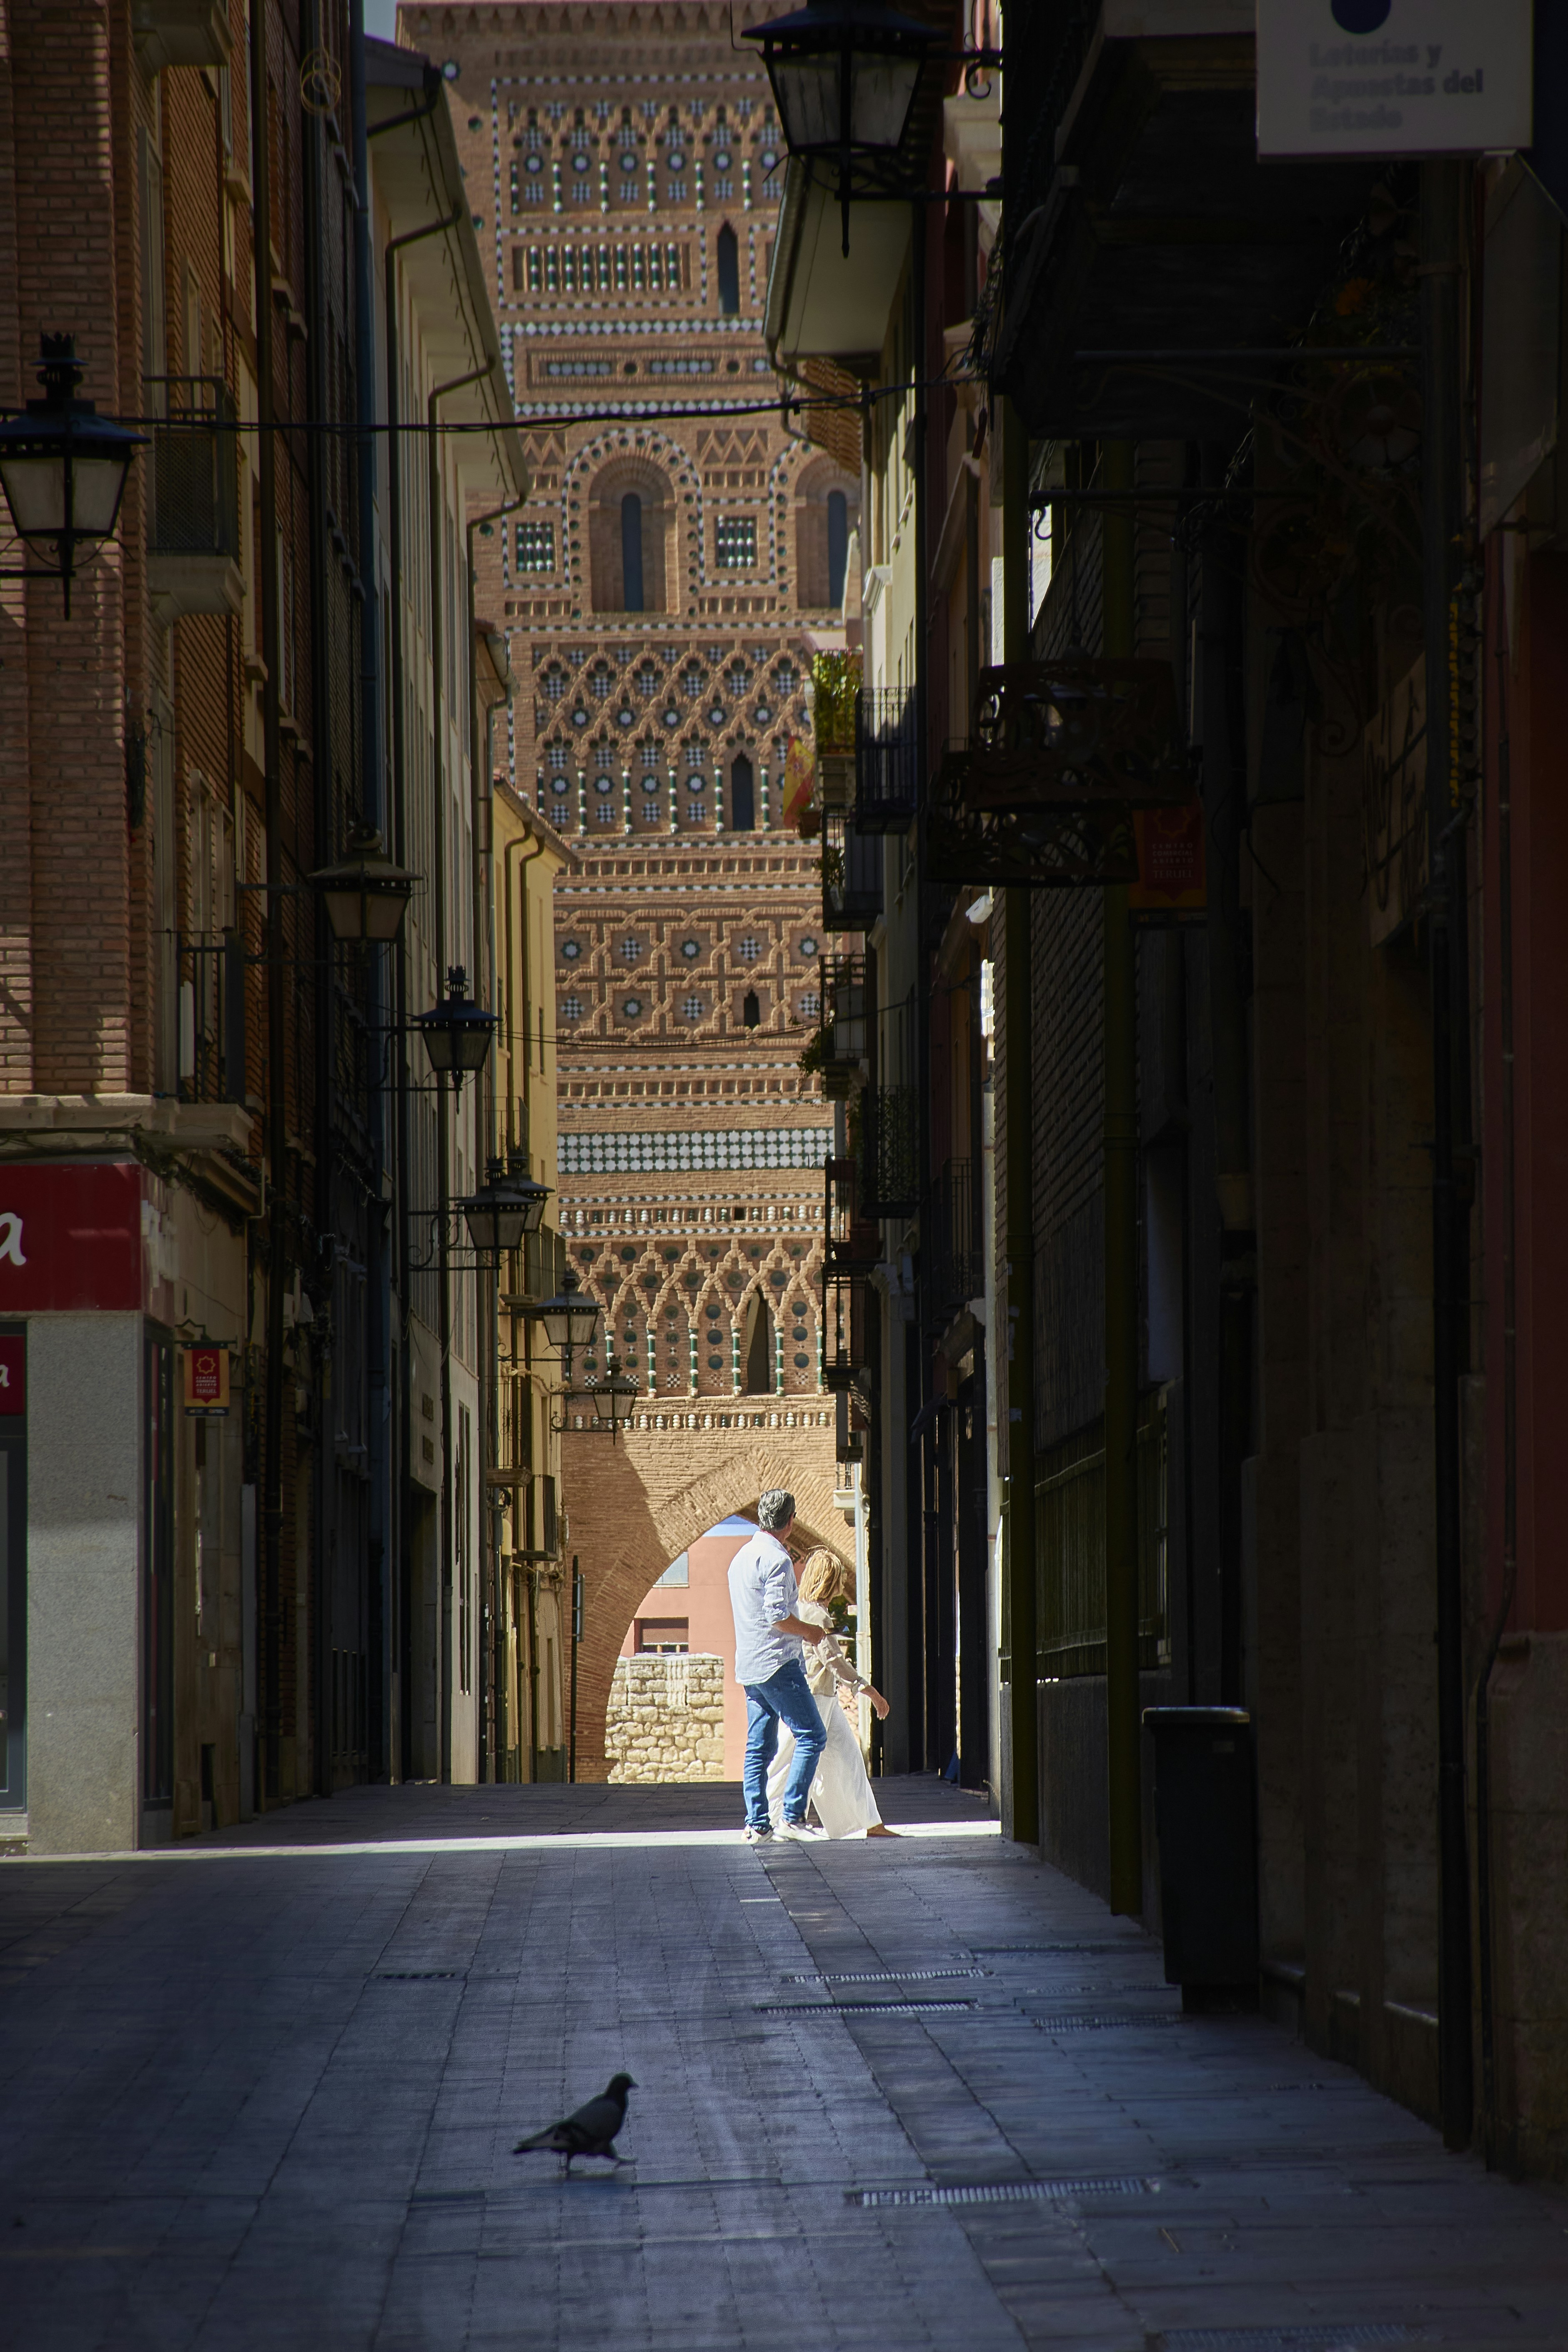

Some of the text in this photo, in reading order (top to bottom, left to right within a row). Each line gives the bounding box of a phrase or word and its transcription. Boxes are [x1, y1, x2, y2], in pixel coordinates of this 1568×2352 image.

[1427, 45, 1442, 68] y
[1311, 68, 1483, 105] Apuestas del
[1310, 104, 1403, 132] Estado
[1153, 870, 1192, 879] TERUEL
